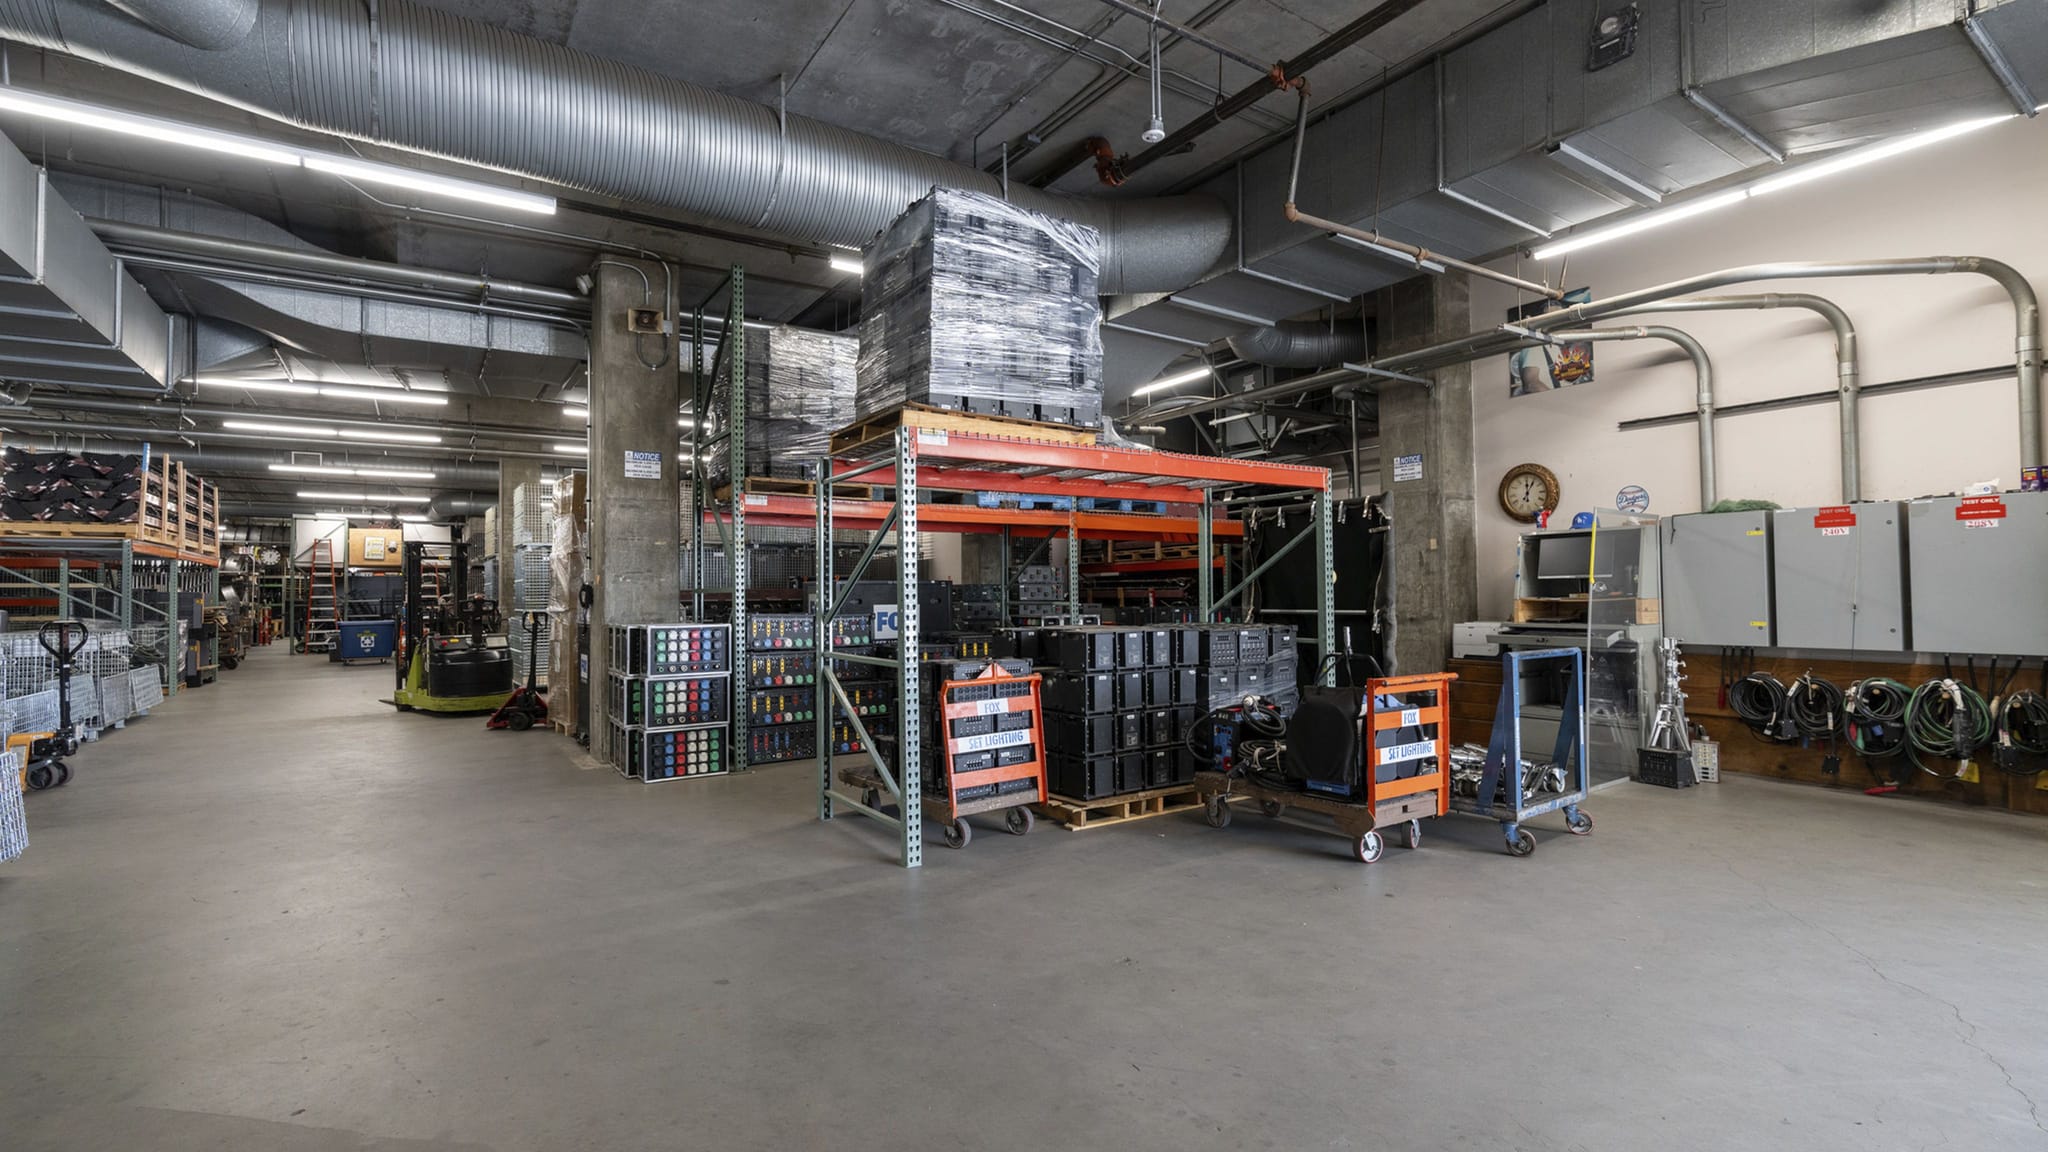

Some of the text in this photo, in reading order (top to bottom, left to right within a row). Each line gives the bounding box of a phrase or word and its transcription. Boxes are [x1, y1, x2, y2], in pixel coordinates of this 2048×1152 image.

[633, 451, 660, 460] NOTICE
[1400, 454, 1421, 464] NOTICE
[984, 701, 1001, 713] FOX
[1403, 711, 1417, 724] FOX
[969, 731, 1024, 749] SET LIGHTING
[1388, 742, 1432, 760] SET LIGHTING
